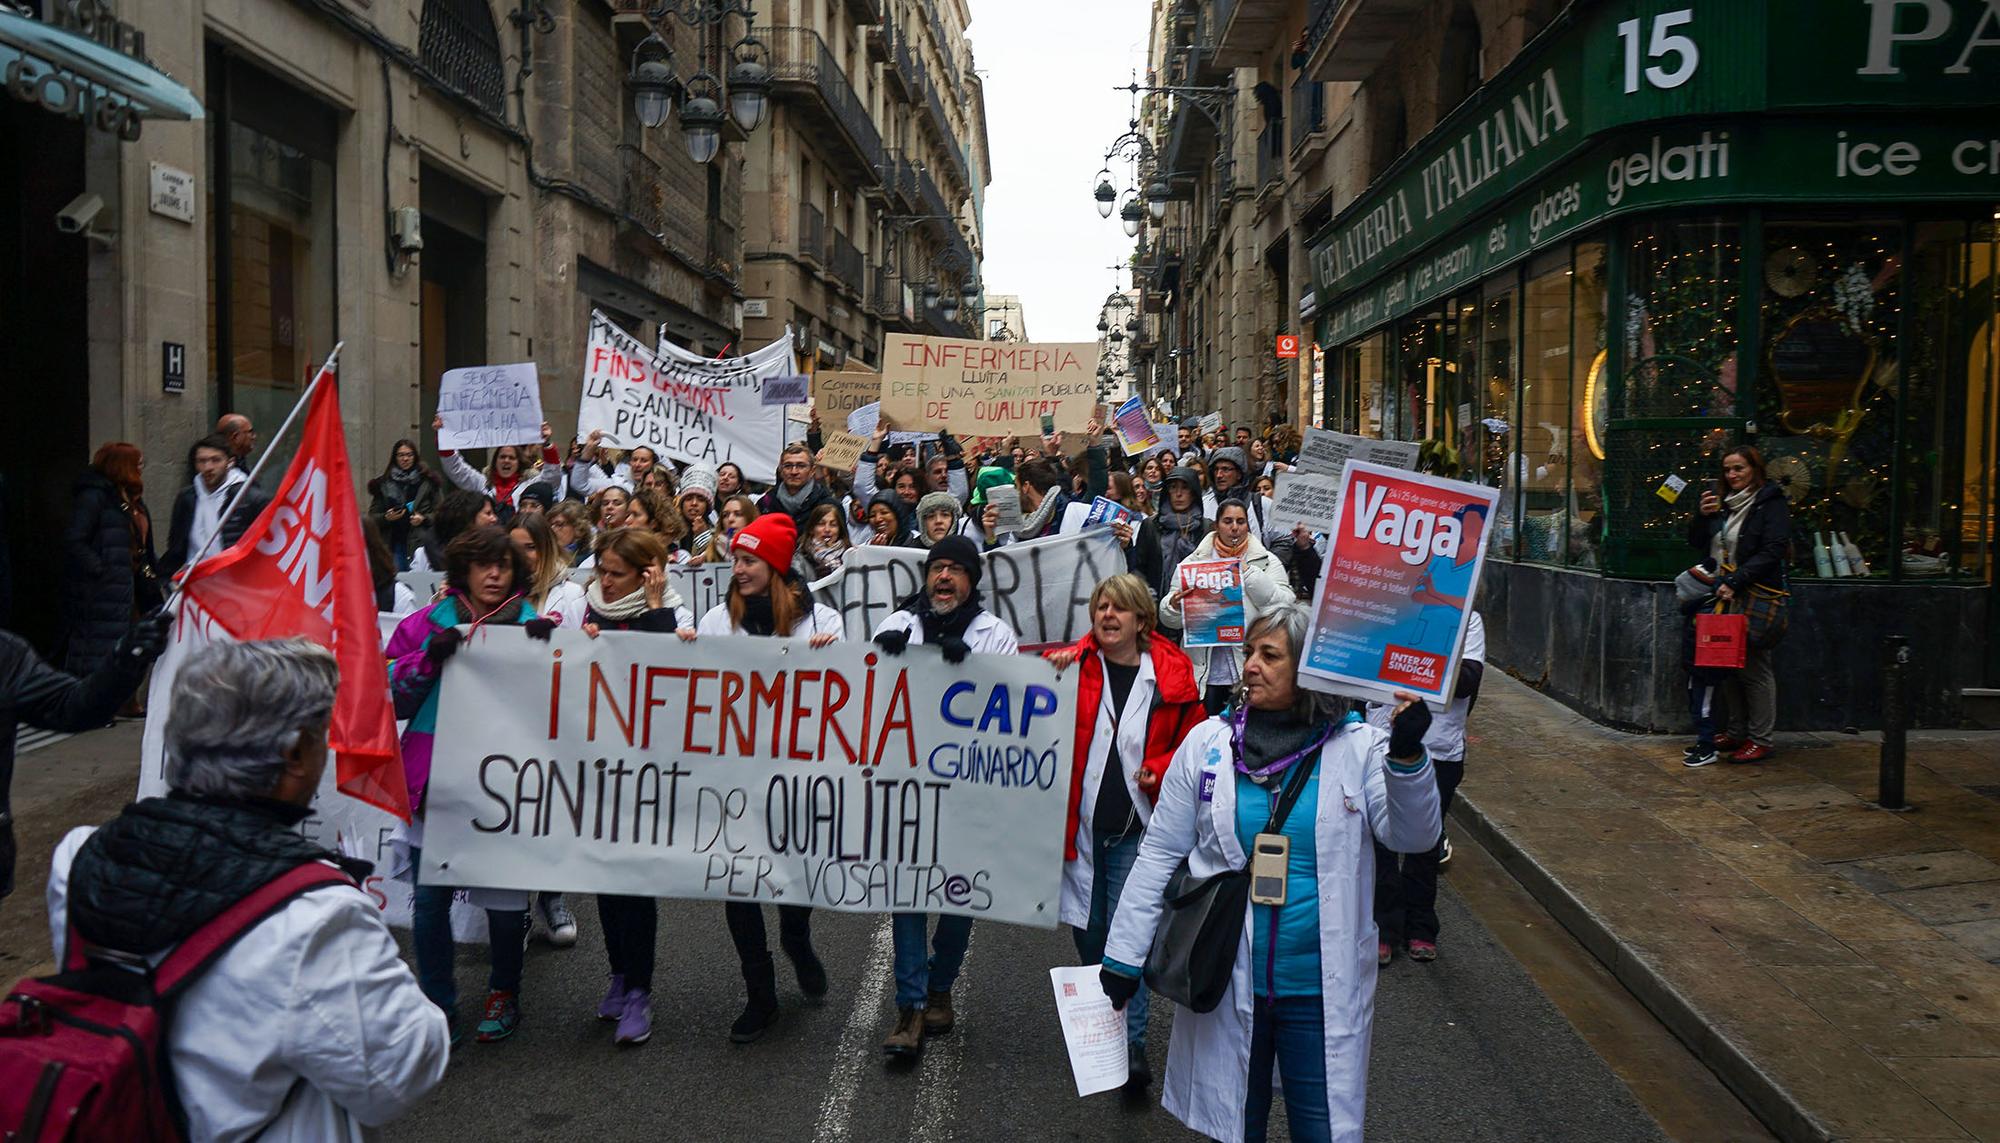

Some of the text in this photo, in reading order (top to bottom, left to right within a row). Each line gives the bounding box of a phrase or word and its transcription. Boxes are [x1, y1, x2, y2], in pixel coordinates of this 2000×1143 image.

[1617, 9, 1699, 94] 15
[1318, 68, 1569, 288] GELATERIA ITALIANA
[1529, 181, 1581, 244] glaces
[1607, 131, 1730, 206] gelati
[1836, 130, 1921, 177] ice
[169, 345, 182, 375] H
[593, 347, 647, 383] FINS
[902, 343, 1082, 372] INFERMERIA
[587, 378, 614, 401] LA
[821, 380, 881, 391] CONTRACTE
[891, 382, 1092, 399] PER UNA SANITAT PÚBLICA
[961, 371, 1008, 384] LLUITA
[926, 400, 1063, 421] DE QUALITAT
[1354, 481, 1462, 566] Vaga
[1336, 557, 1352, 569] Una
[1183, 567, 1234, 594] Vaga
[1387, 660, 1436, 679] SINDICAL
[1391, 651, 1420, 666] INTER
[940, 680, 1058, 738] CAP
[704, 853, 783, 899] PER
